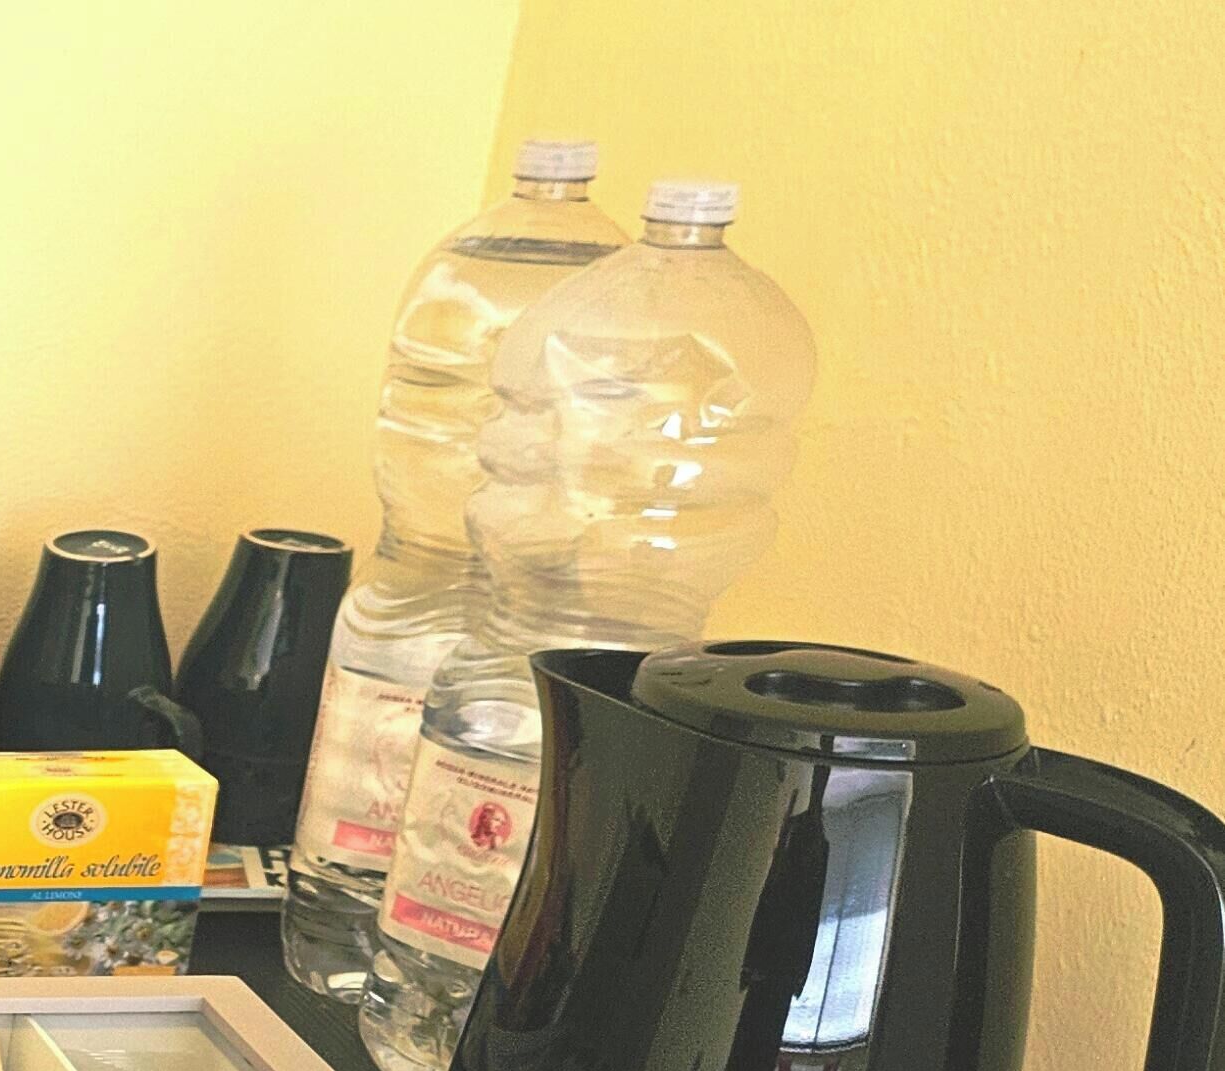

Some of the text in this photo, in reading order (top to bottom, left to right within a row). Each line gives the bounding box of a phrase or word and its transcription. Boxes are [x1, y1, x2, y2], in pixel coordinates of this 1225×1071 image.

[43, 799, 95, 819] LESTER
[41, 822, 94, 841] HOUSE
[79, 852, 162, 879] solubile
[44, 891, 83, 900] LIMONE
